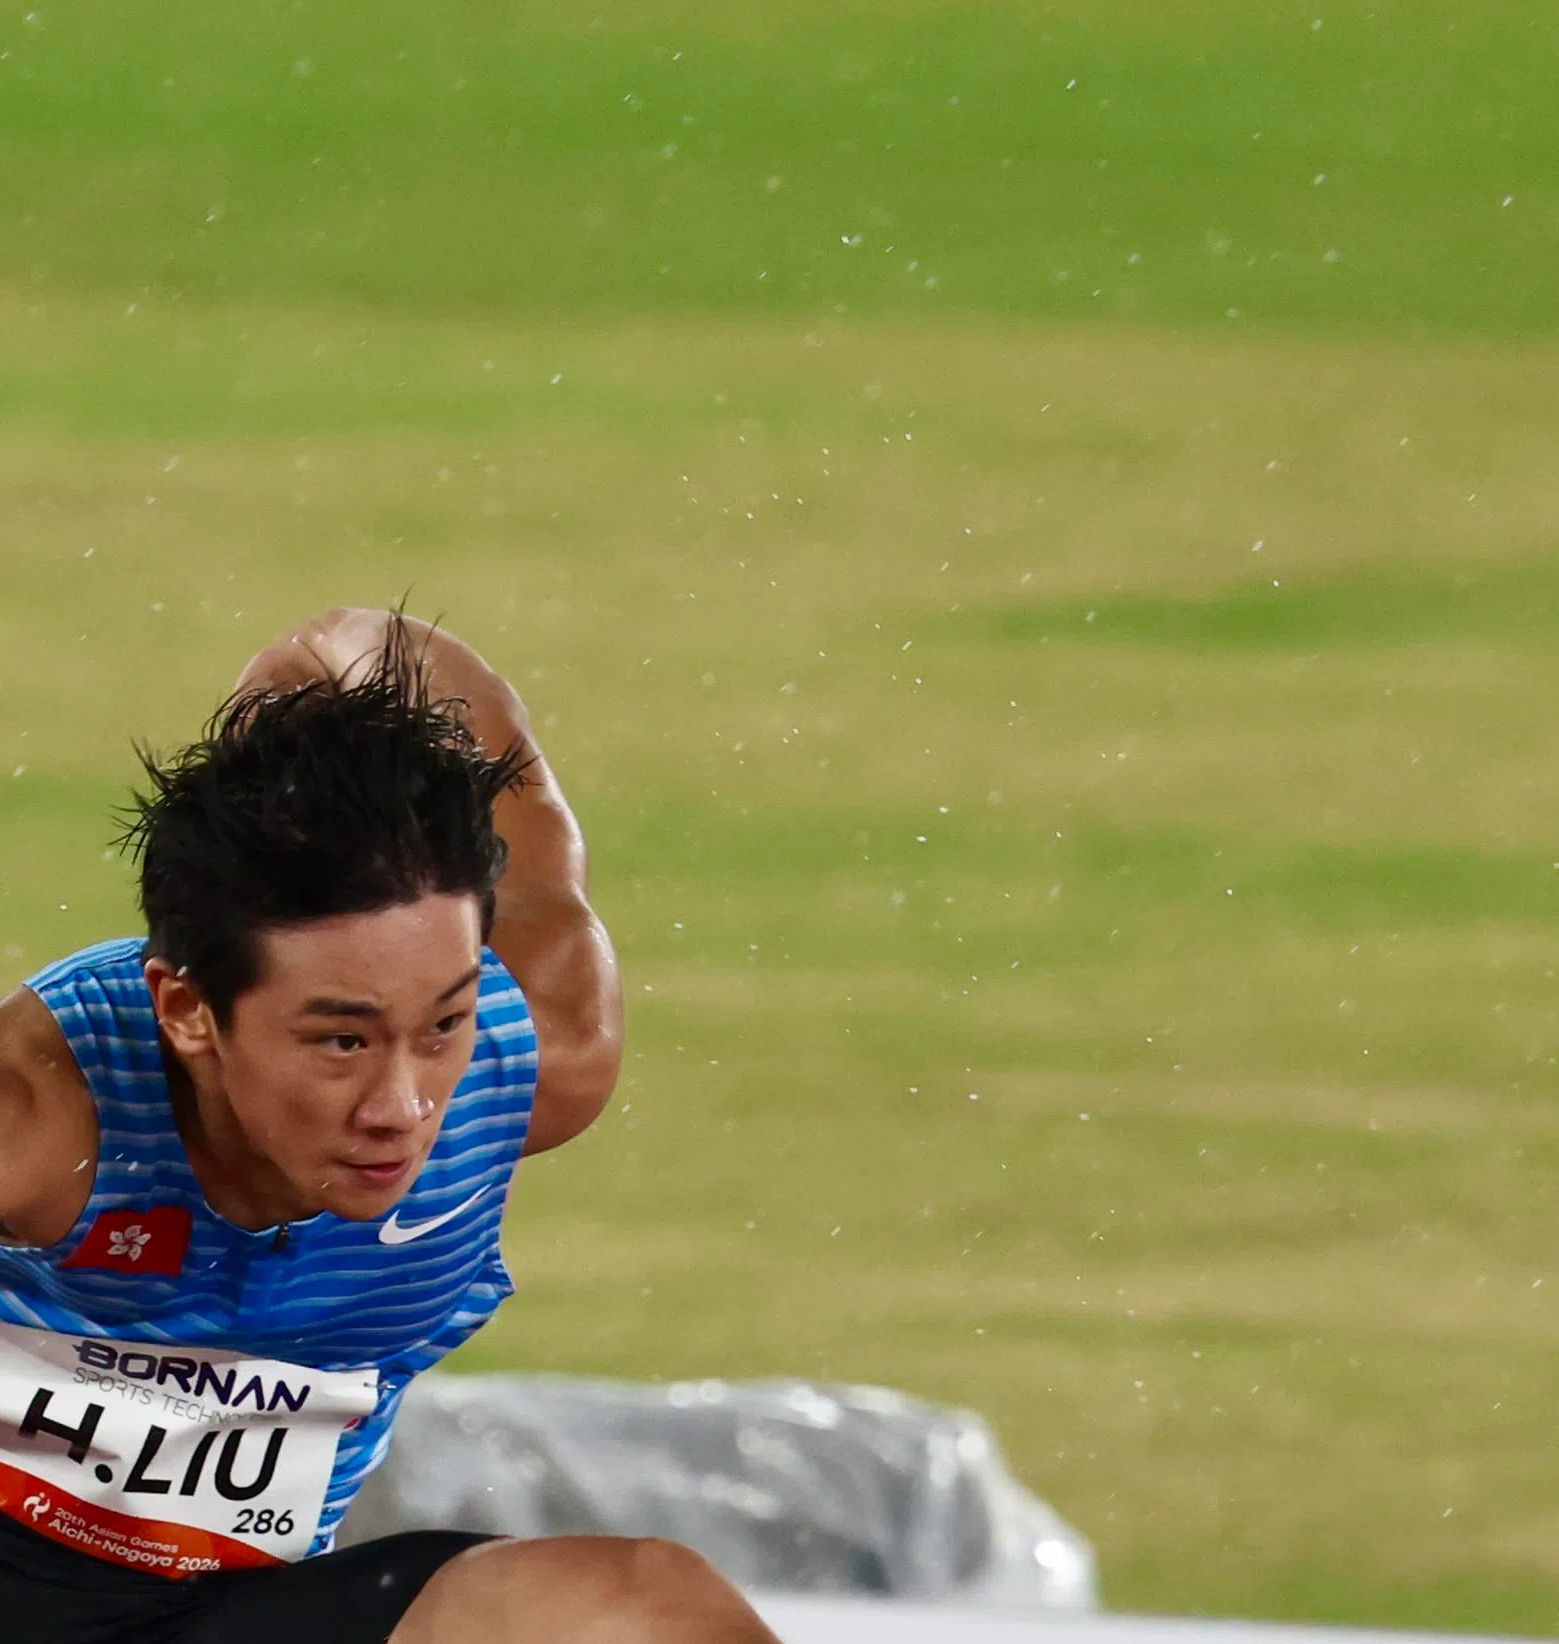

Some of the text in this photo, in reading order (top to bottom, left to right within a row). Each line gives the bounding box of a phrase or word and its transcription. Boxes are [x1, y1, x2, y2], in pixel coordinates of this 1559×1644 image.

[72, 1340, 311, 1412] BORNAN
[73, 1367, 254, 1425] SPORTS TECHN
[17, 1388, 289, 1501] H.LIU
[48, 1518, 221, 1572] Aichi-Nagoya 2026
[54, 1507, 180, 1554] 20th Asian Games
[232, 1508, 295, 1536] 286
